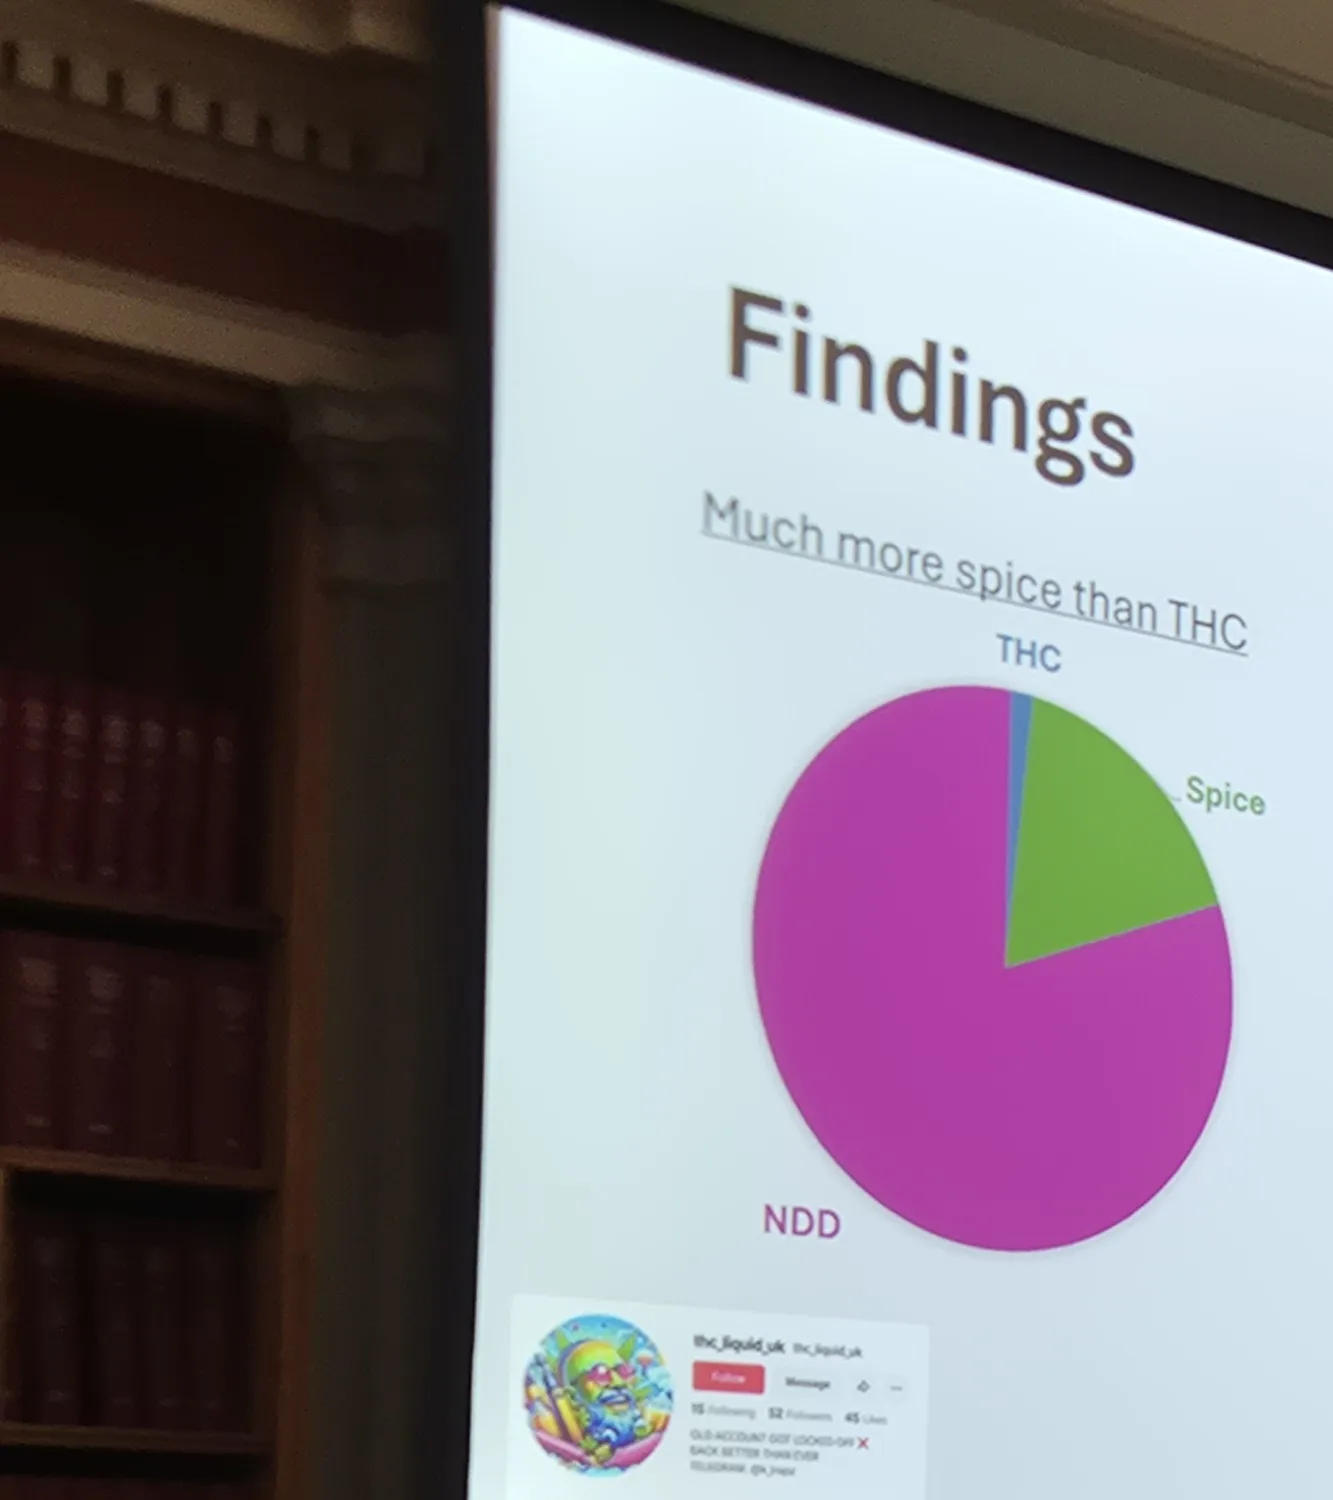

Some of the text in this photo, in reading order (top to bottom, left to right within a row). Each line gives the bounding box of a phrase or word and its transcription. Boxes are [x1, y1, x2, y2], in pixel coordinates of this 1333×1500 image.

[728, 286, 1136, 486] Findings
[702, 490, 1249, 651] Much more spice than THC
[996, 634, 1063, 673] THC
[1186, 776, 1267, 816] Spice
[763, 1204, 841, 1241] NDD
